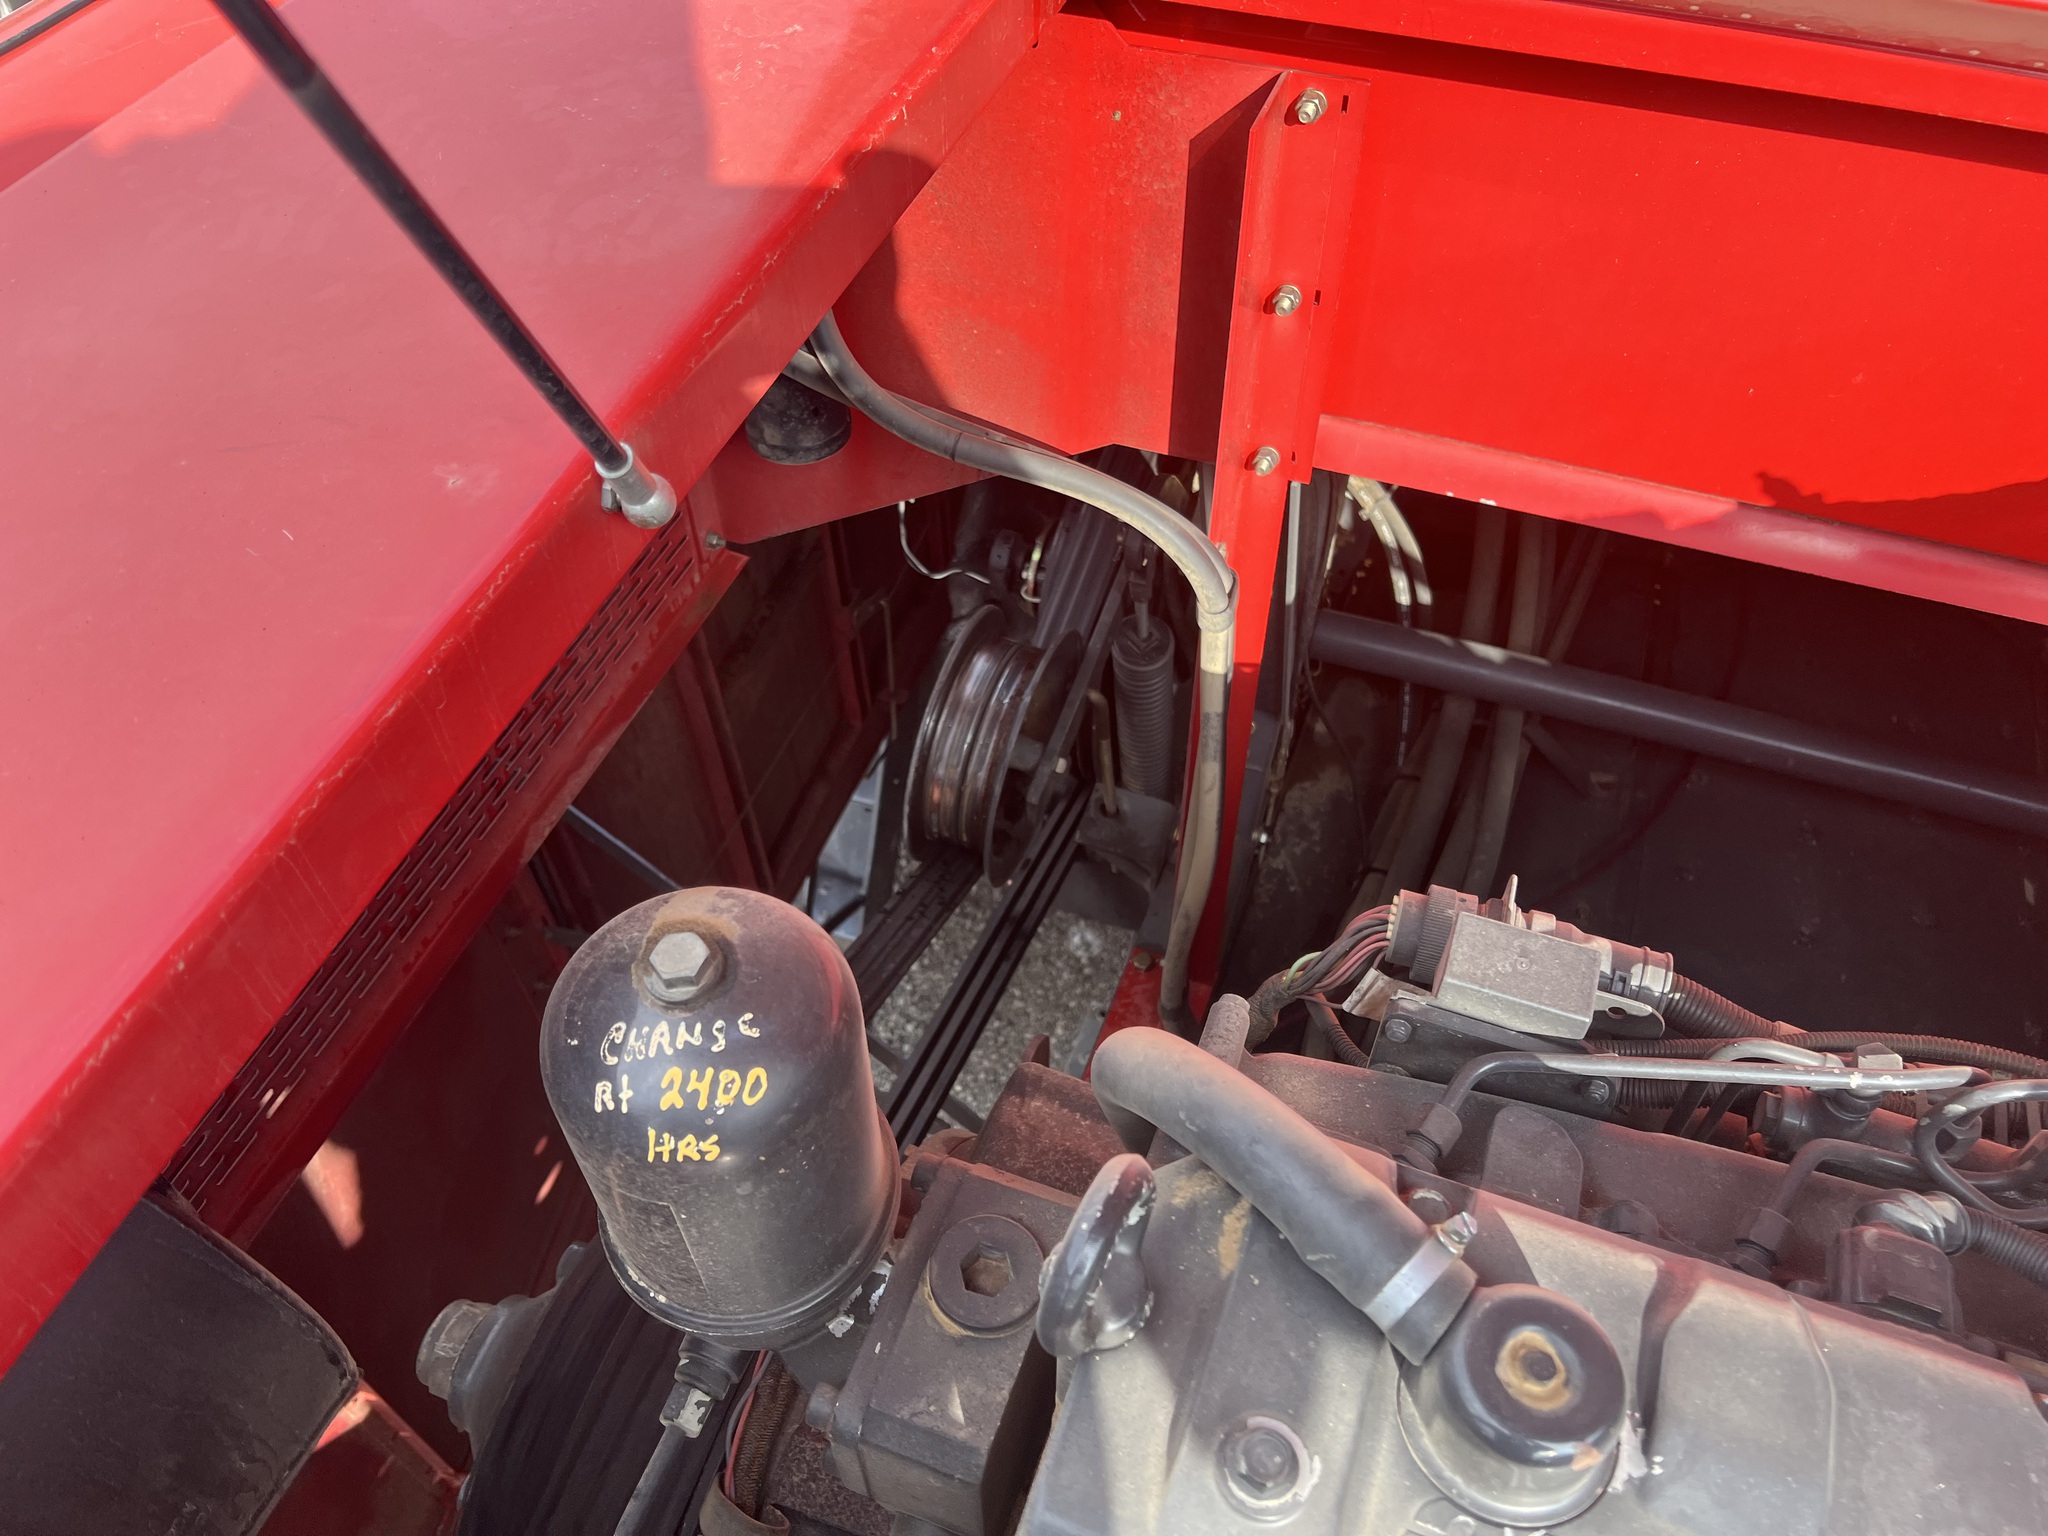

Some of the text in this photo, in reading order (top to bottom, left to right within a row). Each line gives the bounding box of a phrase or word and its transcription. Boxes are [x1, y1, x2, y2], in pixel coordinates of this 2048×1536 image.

[600, 1013, 761, 1065] CHANGE
[660, 1067, 768, 1111] 2400
[647, 1127, 721, 1162] HRS
